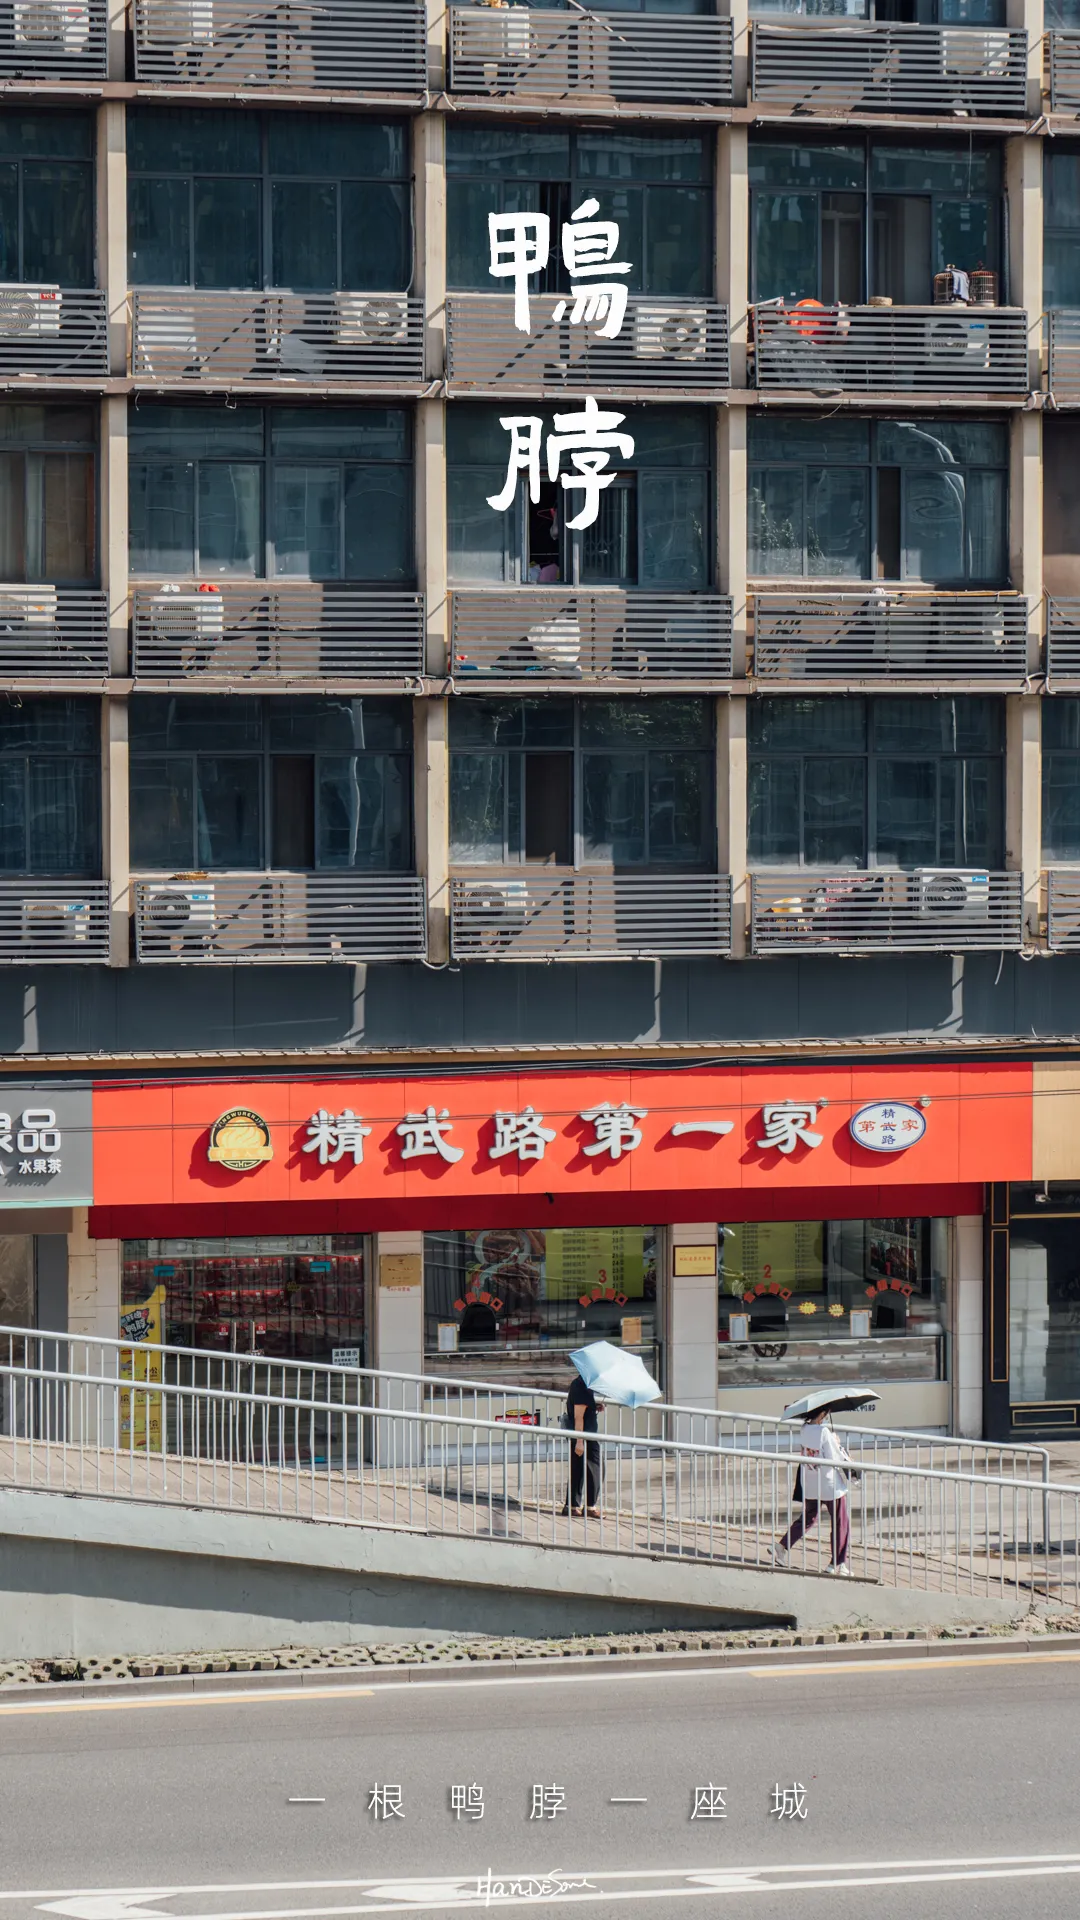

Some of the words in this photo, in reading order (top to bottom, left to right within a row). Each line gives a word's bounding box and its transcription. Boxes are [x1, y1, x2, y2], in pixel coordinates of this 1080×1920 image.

[302, 1100, 824, 1164] 精武路第一家
[19, 1159, 61, 1174] 水果茶
[598, 1269, 607, 1283] 3
[763, 1264, 772, 1278] 2
